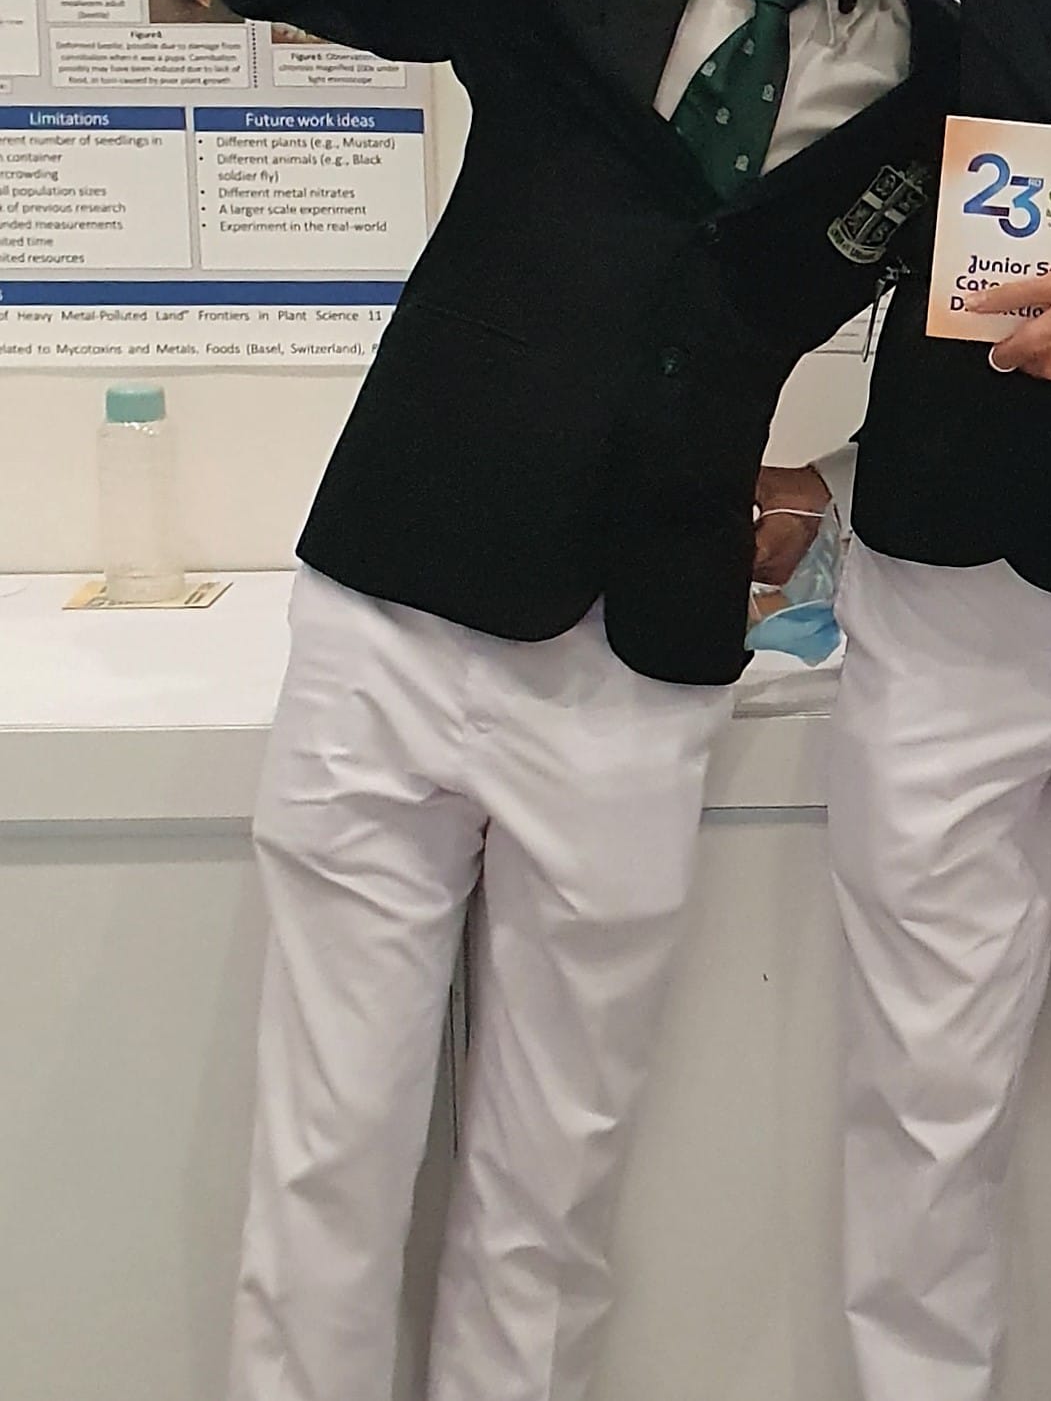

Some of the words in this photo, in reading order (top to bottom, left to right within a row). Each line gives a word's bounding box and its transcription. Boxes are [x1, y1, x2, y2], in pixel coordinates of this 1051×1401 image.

[30, 113, 109, 125] Limitations
[246, 114, 294, 126] Future
[297, 114, 334, 126] work
[337, 114, 375, 126] ideas
[217, 136, 267, 147] Different
[271, 137, 307, 150] plants
[342, 137, 395, 150] Mustard)
[217, 153, 268, 164] Different
[272, 154, 318, 165] animals
[353, 154, 382, 165] Black
[218, 170, 257, 181] soldier
[260, 170, 279, 184] fly)
[219, 188, 269, 198] Different
[274, 188, 306, 198] metal
[310, 188, 355, 198] nitrates
[963, 153, 1044, 238] 23
[231, 204, 264, 217] larger
[268, 204, 296, 214] scale
[300, 204, 366, 217] experiment
[220, 221, 287, 233] Experiment
[290, 221, 300, 232] in
[304, 221, 323, 232] the
[327, 221, 387, 232] real-world
[968, 255, 1031, 274] Junior
